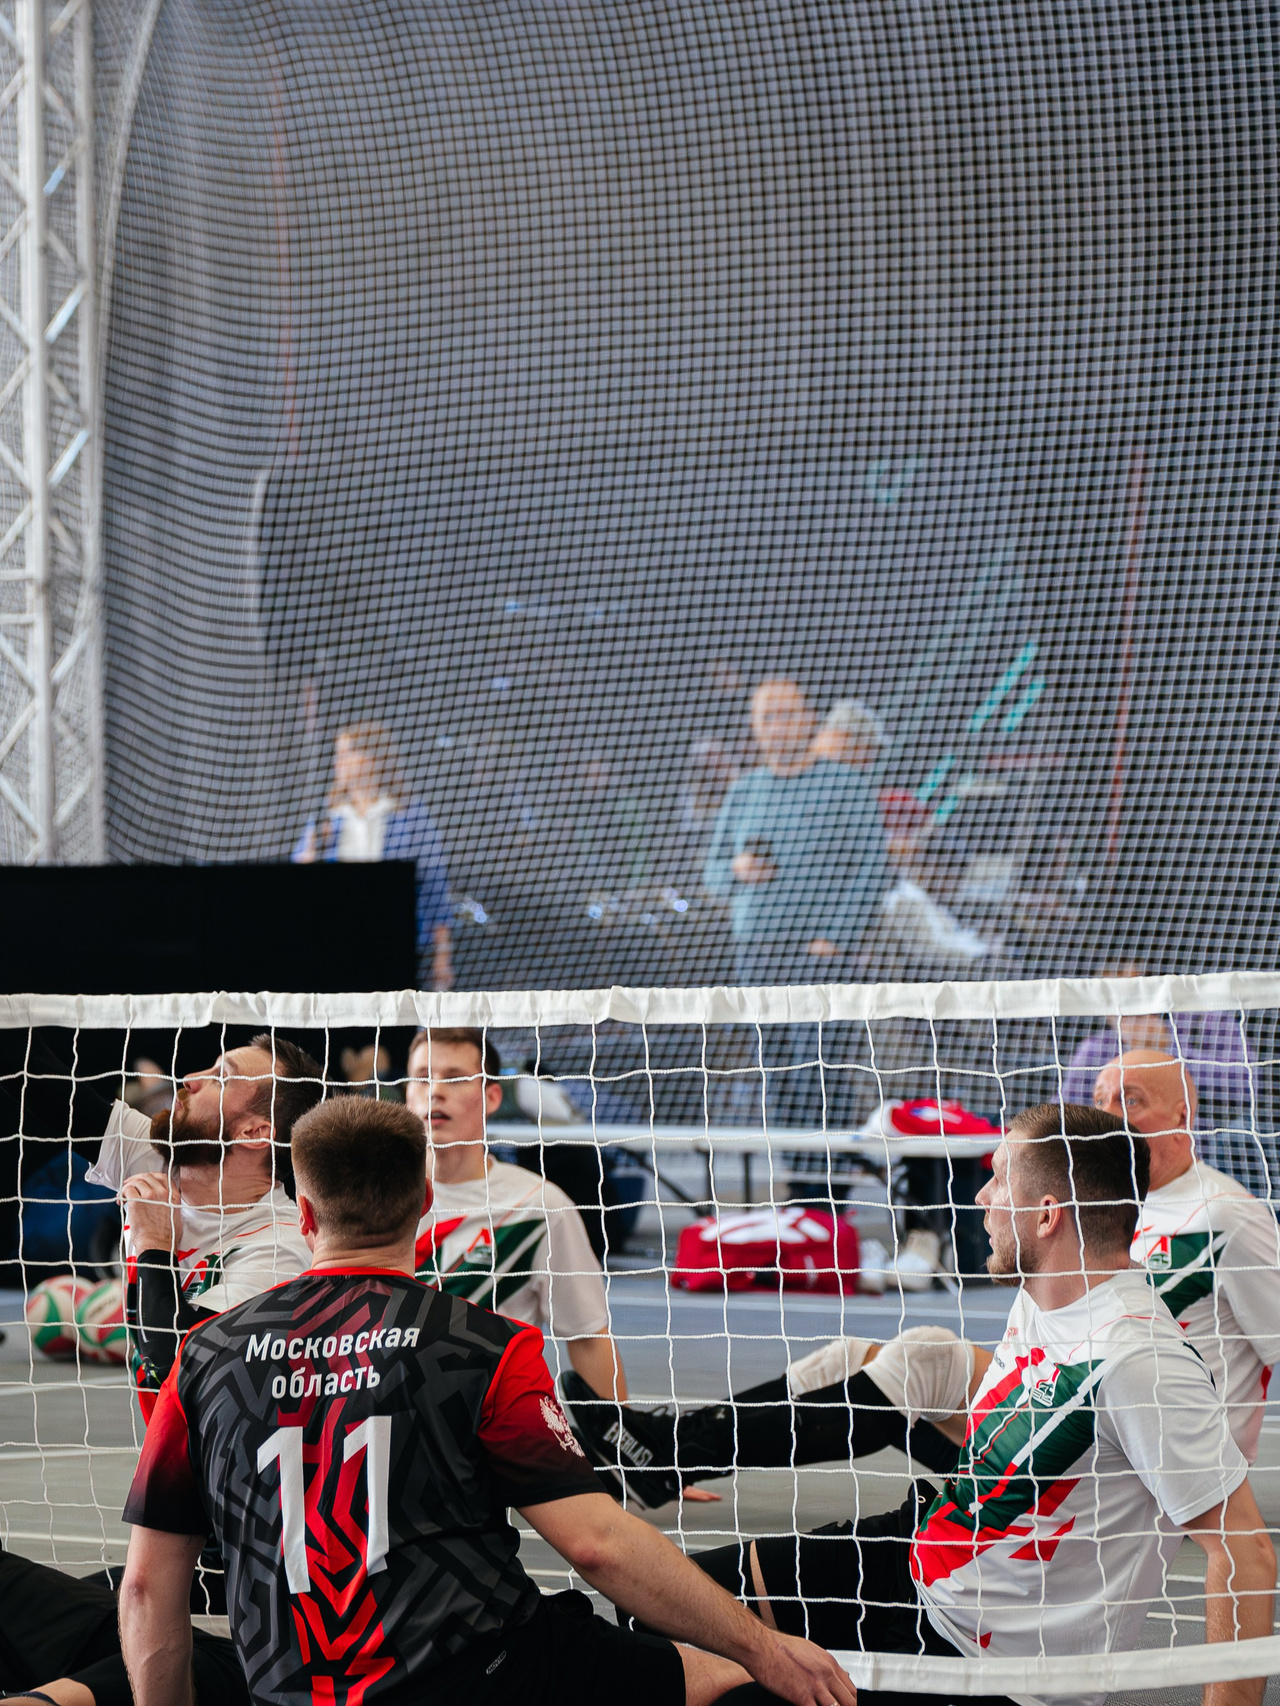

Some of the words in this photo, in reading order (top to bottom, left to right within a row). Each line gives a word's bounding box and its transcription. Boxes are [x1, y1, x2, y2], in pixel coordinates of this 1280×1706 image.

[245, 1327, 421, 1363] Московская
[271, 1366, 381, 1399] область
[257, 1415, 393, 1594] 11
